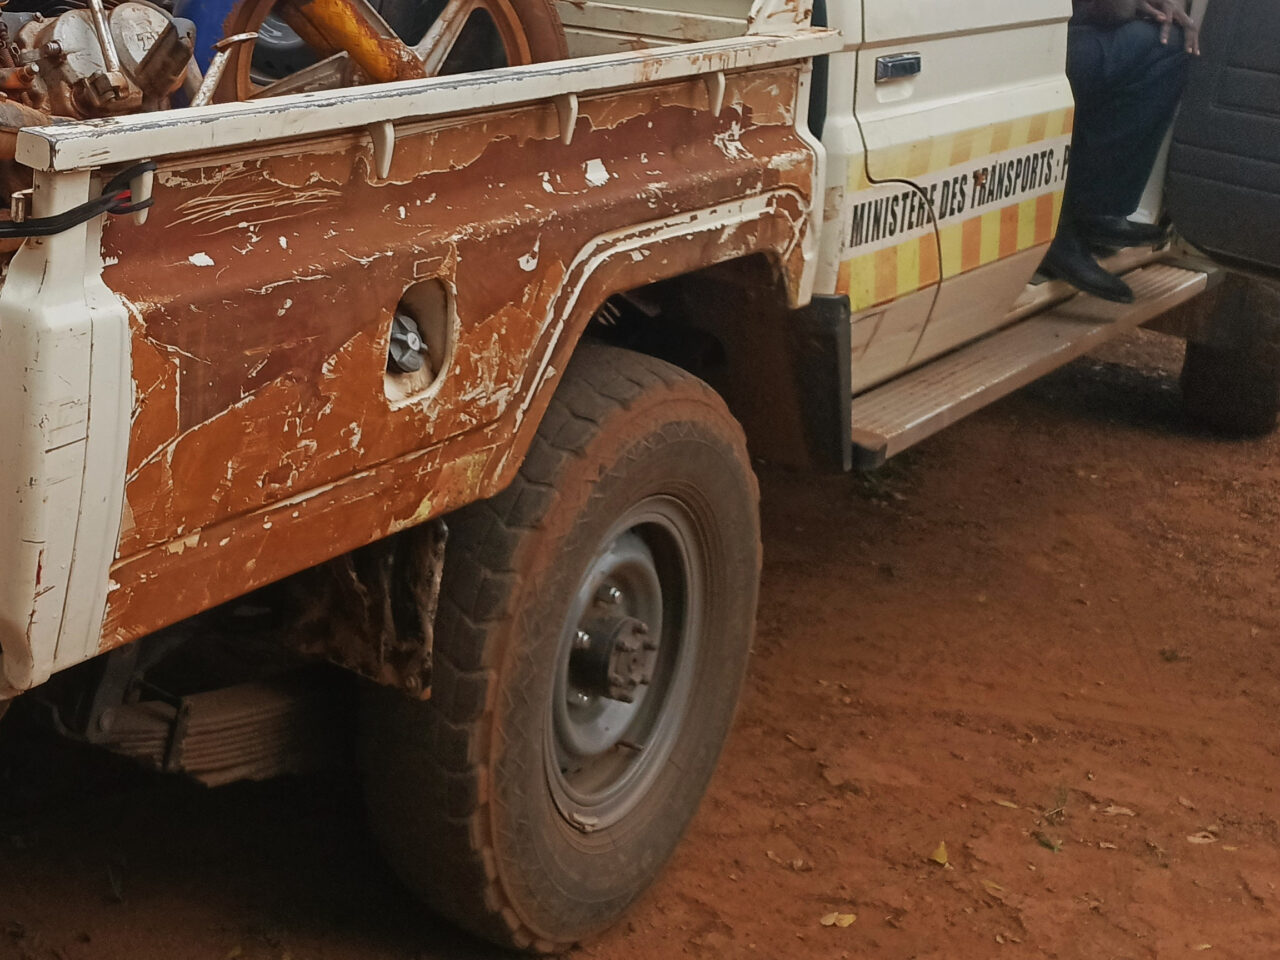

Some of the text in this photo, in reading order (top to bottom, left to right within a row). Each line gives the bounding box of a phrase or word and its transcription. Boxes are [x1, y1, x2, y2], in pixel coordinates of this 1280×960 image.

[849, 183, 938, 248] MINISTERE
[939, 174, 968, 220] DES
[970, 148, 1054, 209] TRANSPORTS
